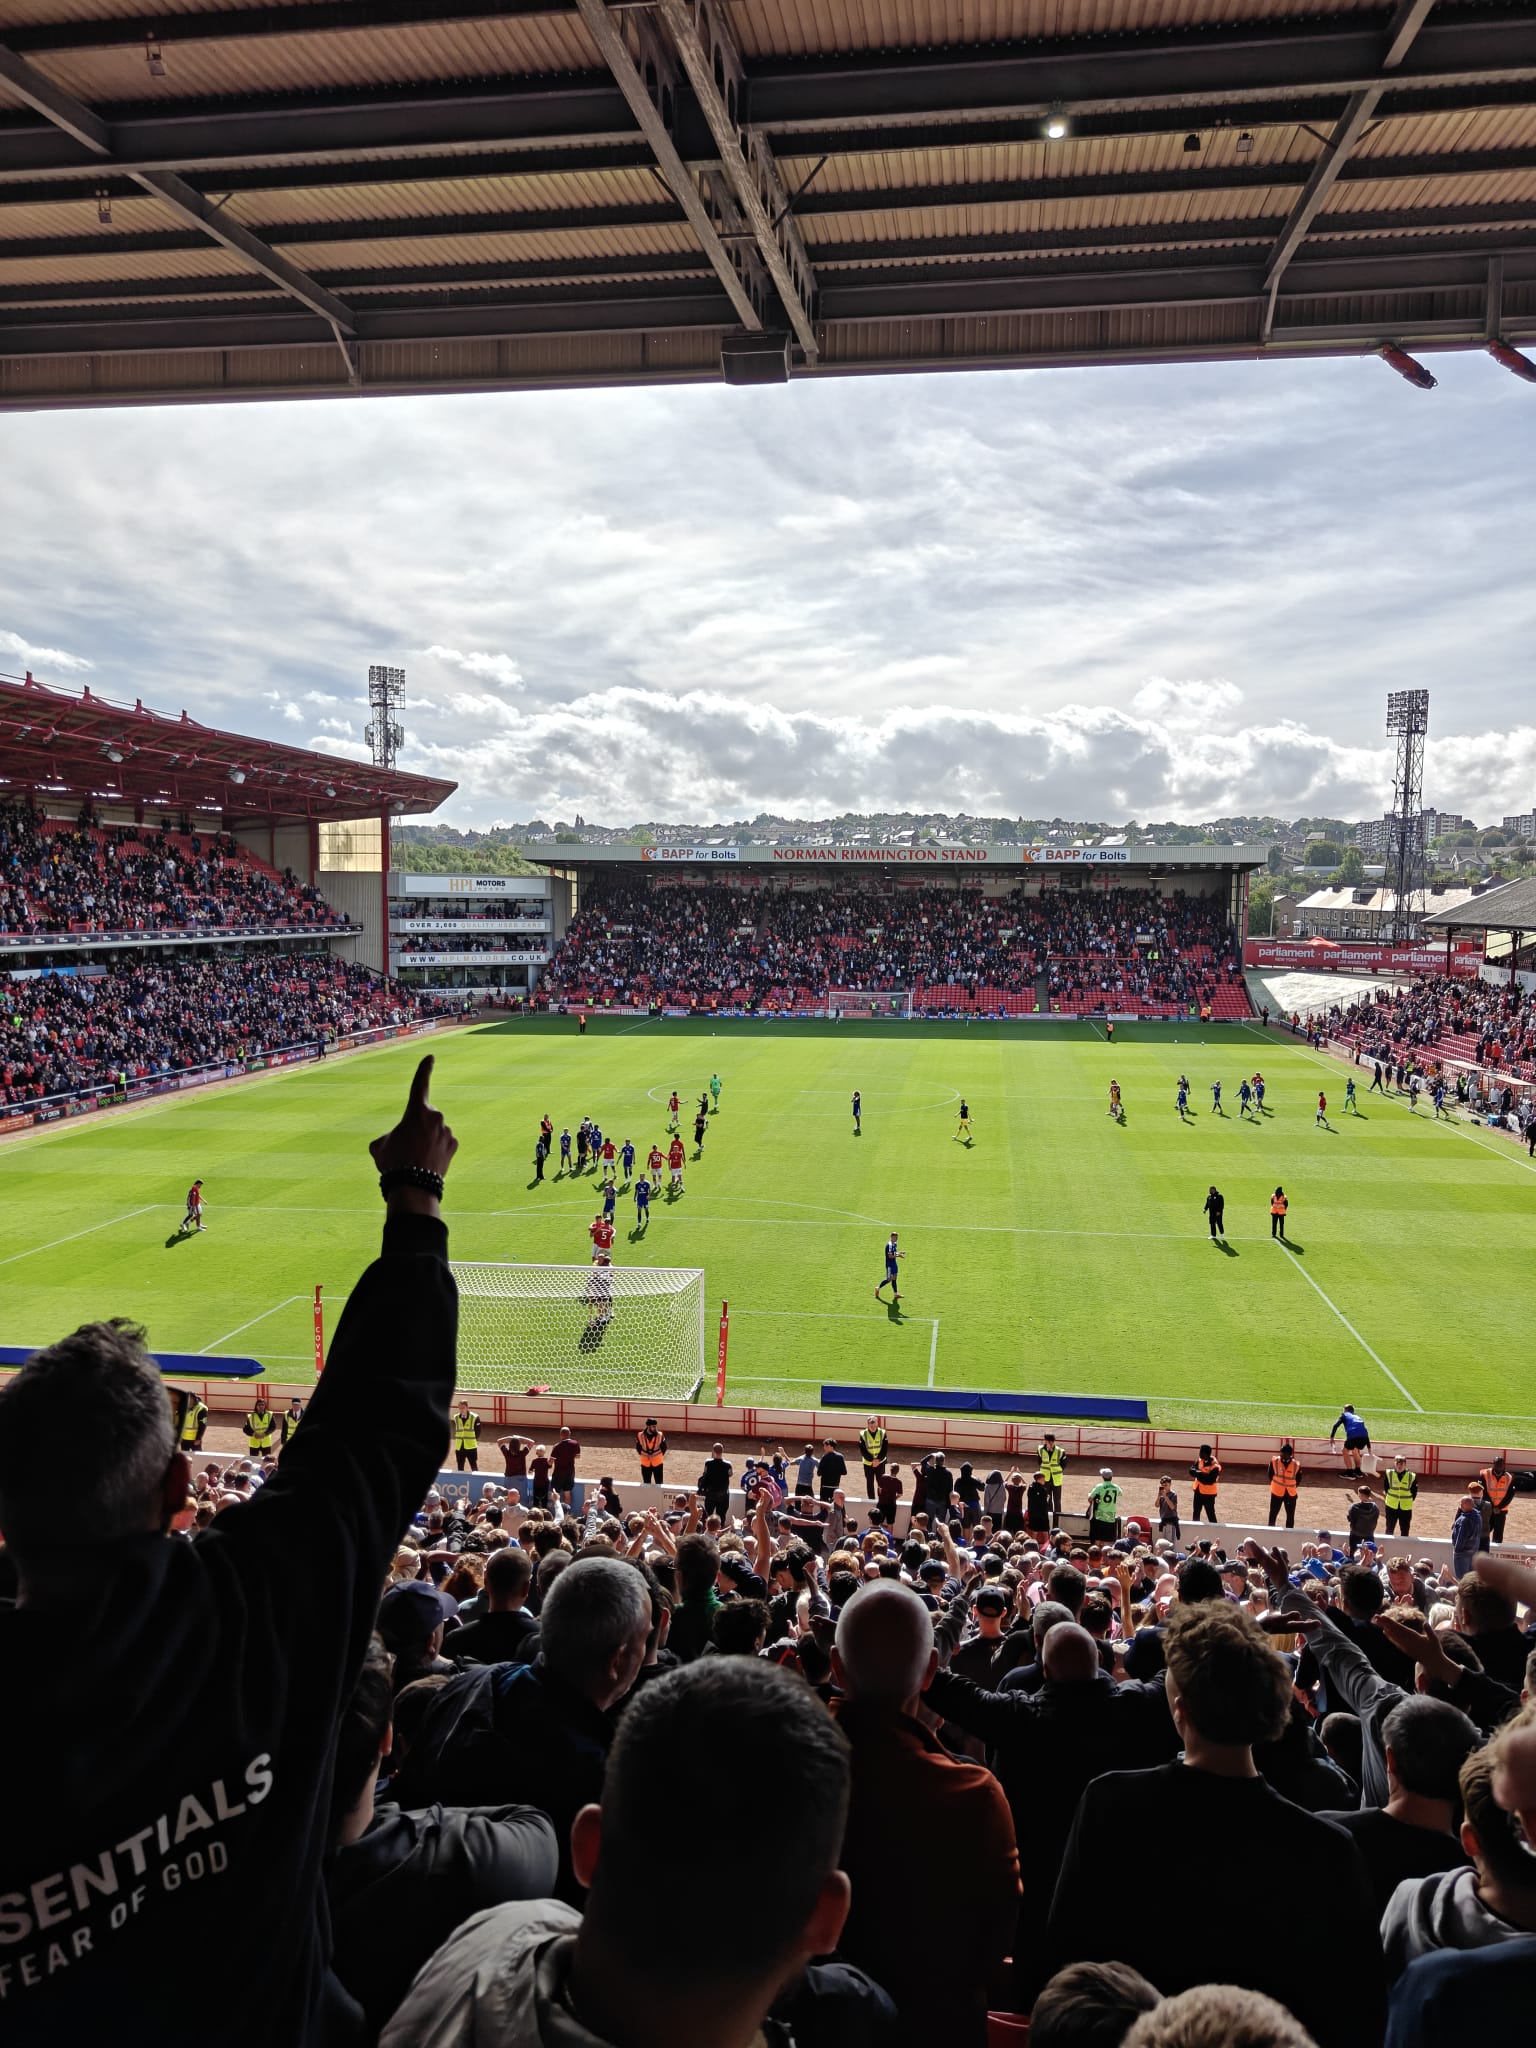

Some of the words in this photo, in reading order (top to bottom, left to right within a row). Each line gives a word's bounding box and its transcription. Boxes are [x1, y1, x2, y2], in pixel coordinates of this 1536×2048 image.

[662, 849, 694, 859] BAPP
[695, 850, 710, 859] for
[711, 850, 737, 860] Bolts
[773, 849, 837, 860] NORMAN
[841, 849, 937, 861] RIMMINGTON
[941, 850, 988, 861] STAND
[1045, 849, 1081, 860] BAPP
[1082, 851, 1097, 861] for
[1099, 851, 1127, 861] Bolts
[449, 878, 477, 892] HPL
[409, 954, 542, 963] WWW.HPLMOTORS.CO.UK
[1259, 946, 1315, 958] parliament
[1323, 949, 1383, 961] parliament
[1391, 951, 1448, 964] parliamen
[601, 1231, 607, 1240] 5
[717, 1341, 725, 1375] COYR
[1103, 1490, 1117, 1504] 61
[0, 1753, 273, 1944] SENTIALS
[0, 1926, 94, 1999] FEAR
[110, 1884, 147, 1930] OF
[162, 1840, 229, 1892] GOD
